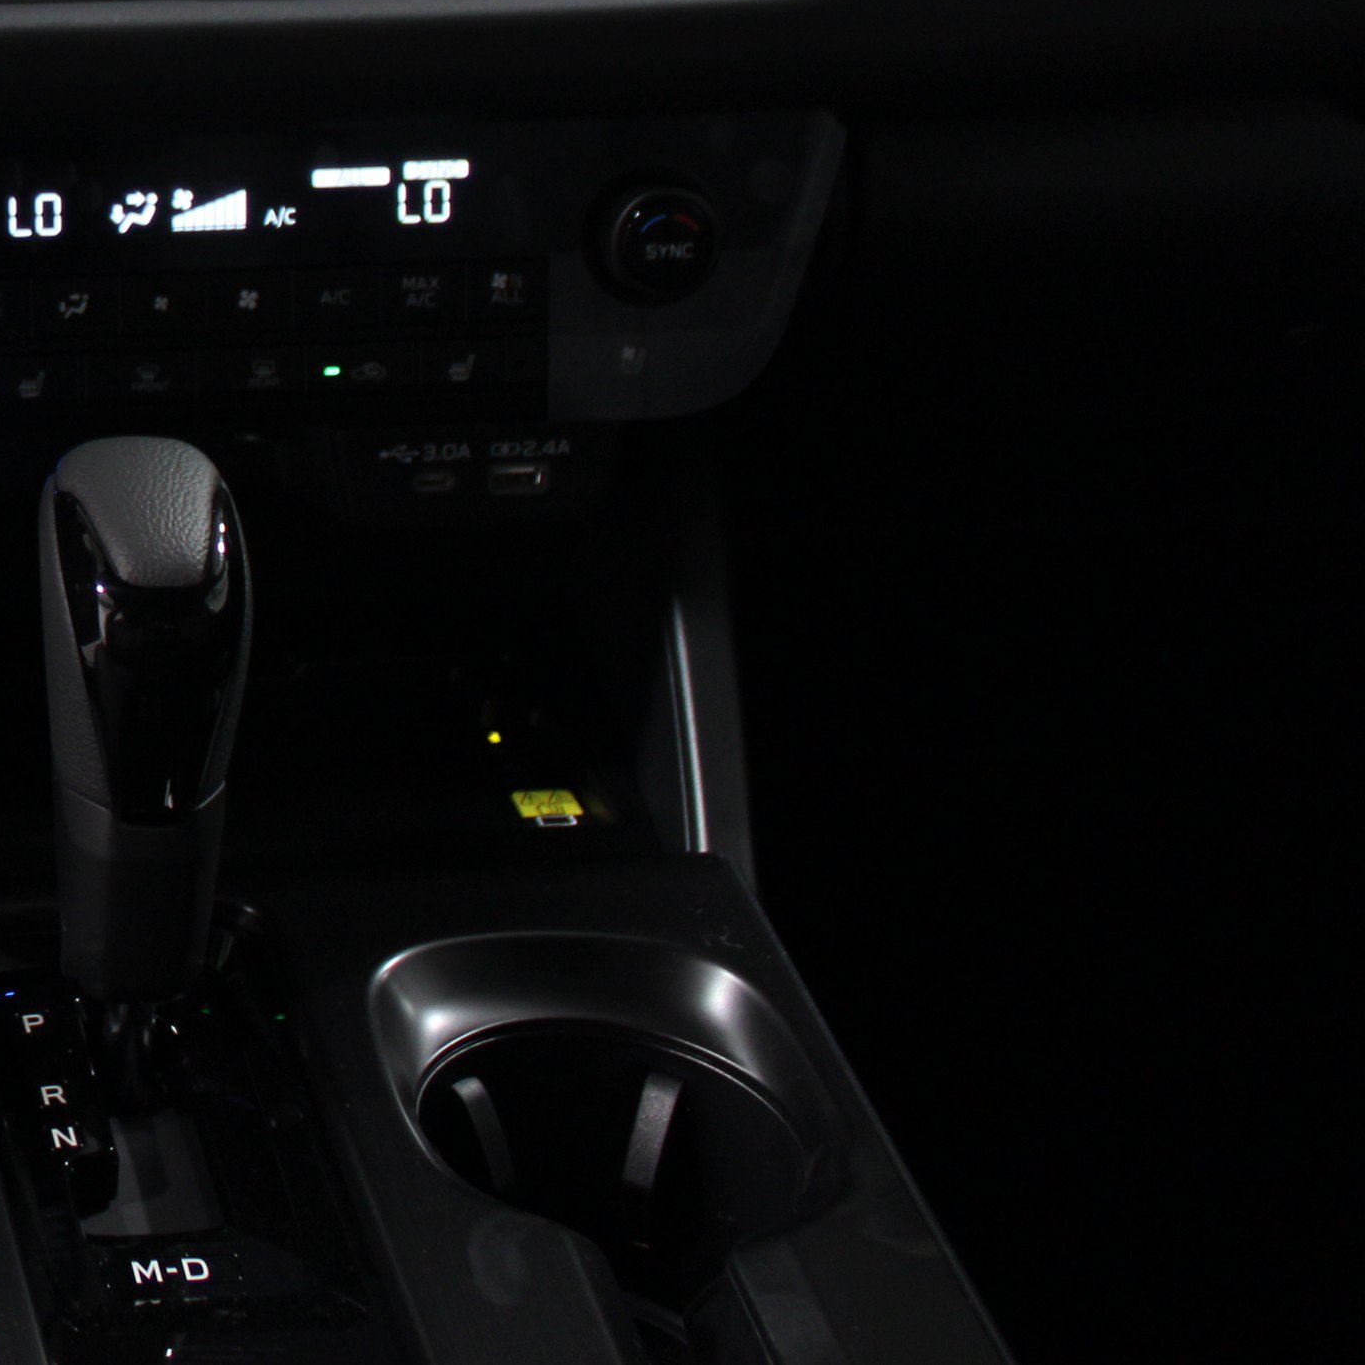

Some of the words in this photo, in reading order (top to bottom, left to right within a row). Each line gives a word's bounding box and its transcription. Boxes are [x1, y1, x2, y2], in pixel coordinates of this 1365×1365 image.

[264, 206, 297, 228] A/C
[645, 242, 694, 260] SYNC
[402, 276, 440, 290] MAX
[319, 289, 351, 304] A/C
[406, 292, 437, 307] A/C
[491, 290, 524, 304] ALL
[422, 443, 470, 461] 3.0A
[522, 440, 570, 457] 2.4A
[22, 1013, 46, 1034] P
[39, 1084, 69, 1107] R
[50, 1126, 79, 1149] N
[130, 1257, 210, 1285] M-D
